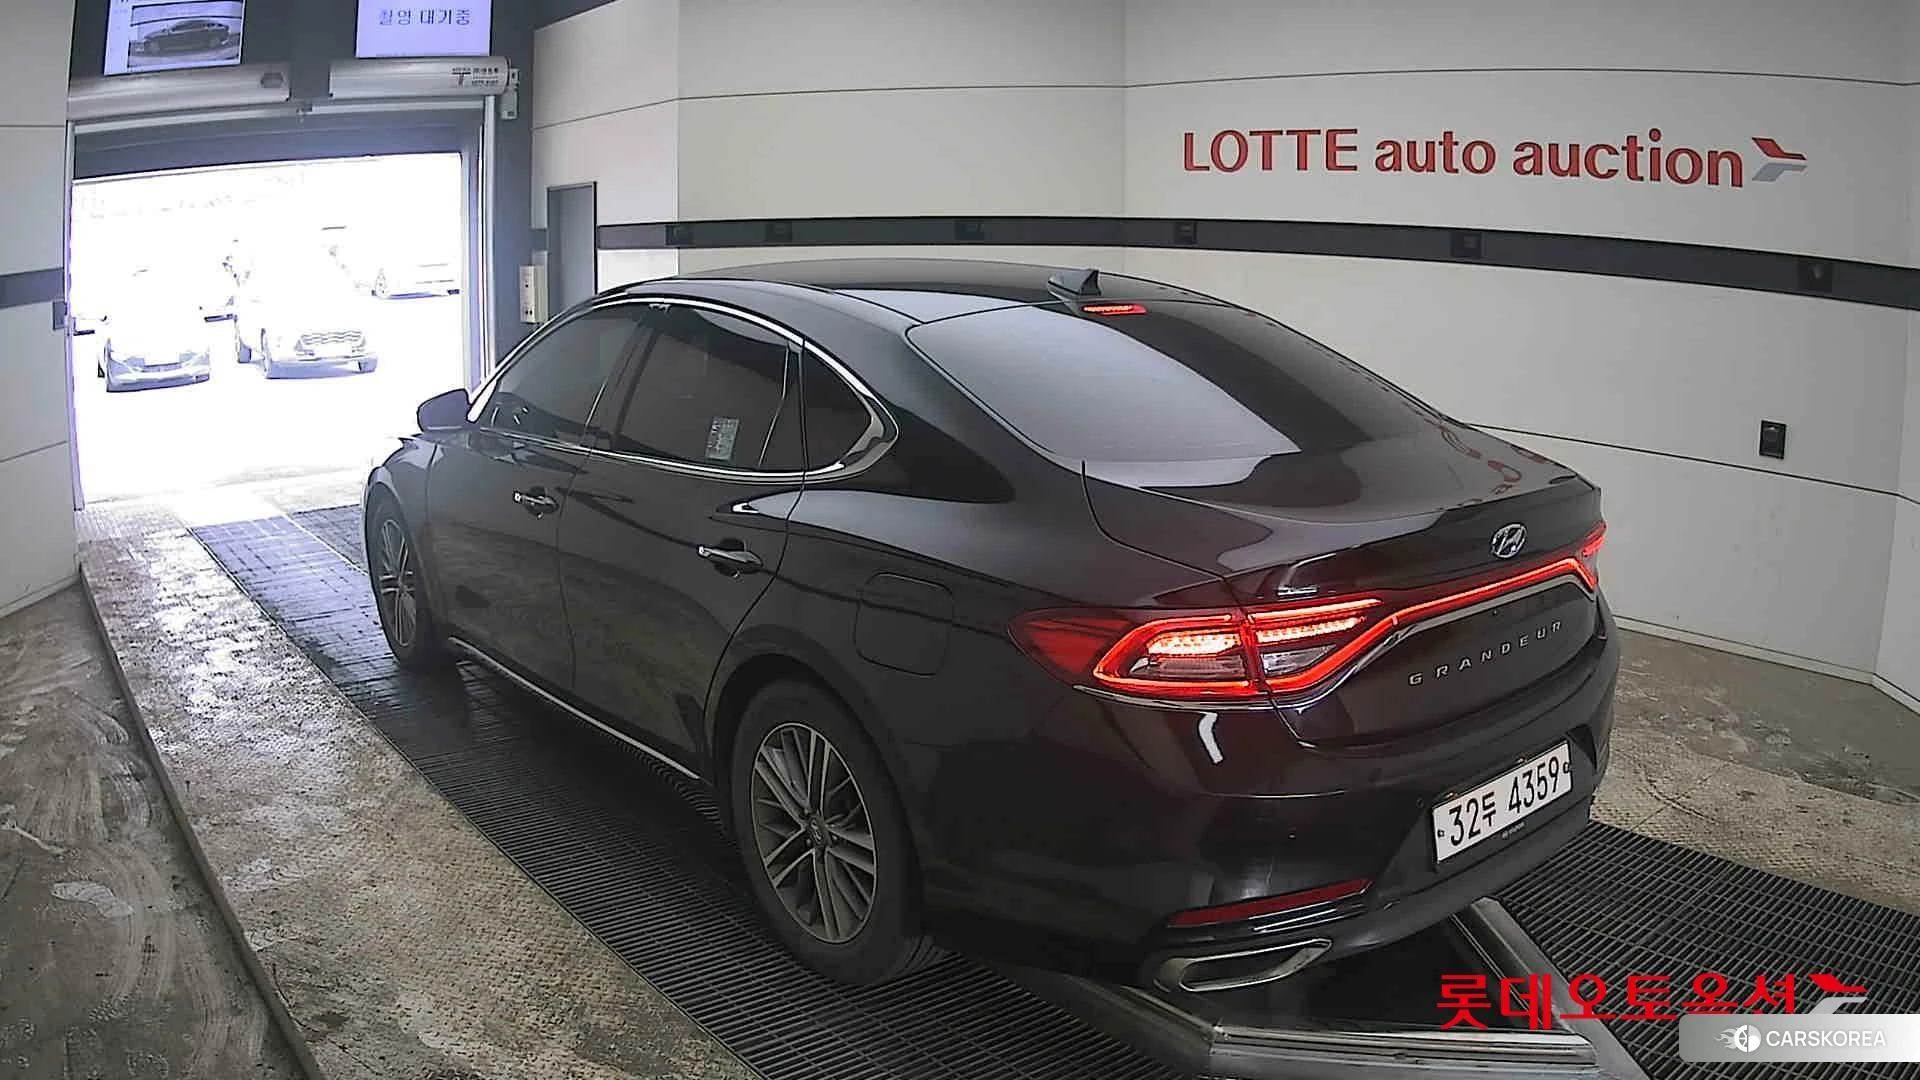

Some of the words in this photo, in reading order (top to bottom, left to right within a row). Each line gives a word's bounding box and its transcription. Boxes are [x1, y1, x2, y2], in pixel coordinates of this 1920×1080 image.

[420, 8, 471, 26] 대기중
[1183, 128, 1358, 174] LOTTE
[1374, 130, 1497, 174] auto
[1512, 127, 1744, 188] auction
[1408, 620, 1562, 686] GRANDEUR
[1448, 791, 1497, 847] 32두
[1508, 756, 1560, 814] 4359
